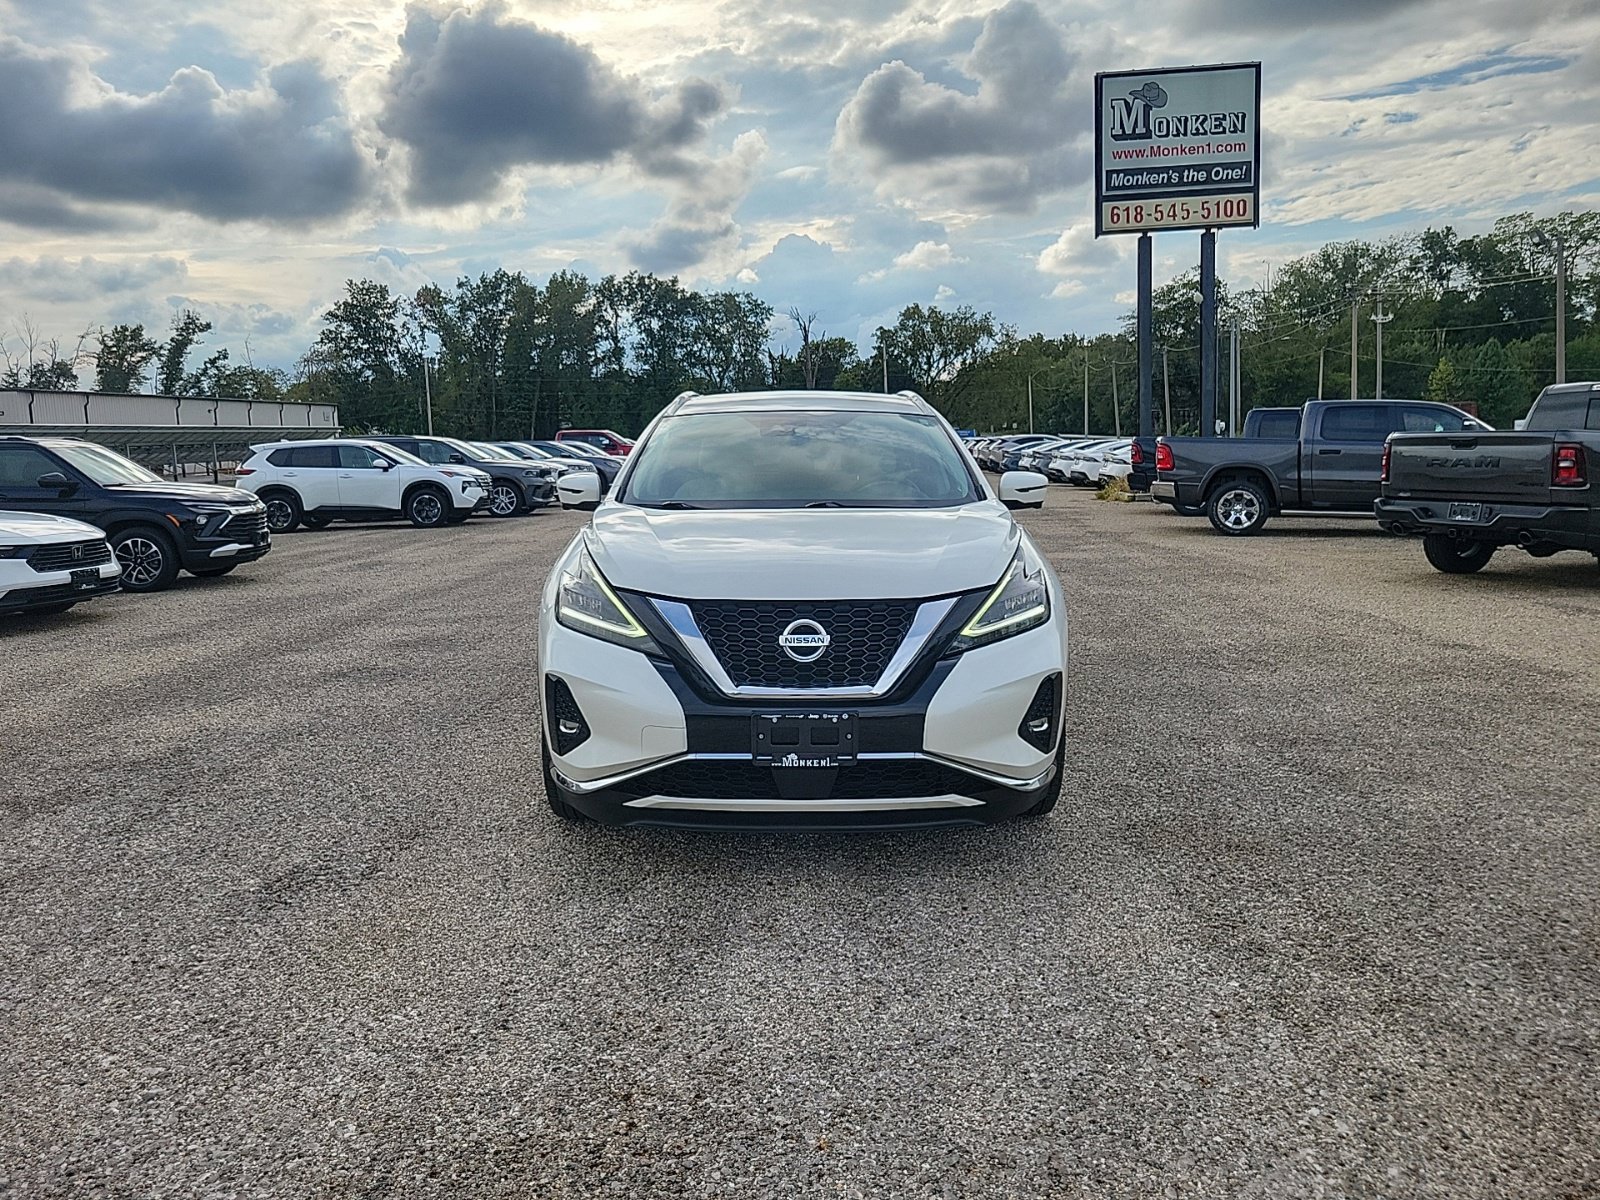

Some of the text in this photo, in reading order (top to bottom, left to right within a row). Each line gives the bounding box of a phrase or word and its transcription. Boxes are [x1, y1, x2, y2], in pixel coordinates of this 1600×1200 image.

[1112, 142, 1246, 160] www.Monken1.com
[1111, 165, 1247, 187] Monken's the One!
[1110, 199, 1248, 225] 618-545-5100
[1426, 457, 1501, 468] RAM
[784, 636, 825, 645] NISSAN
